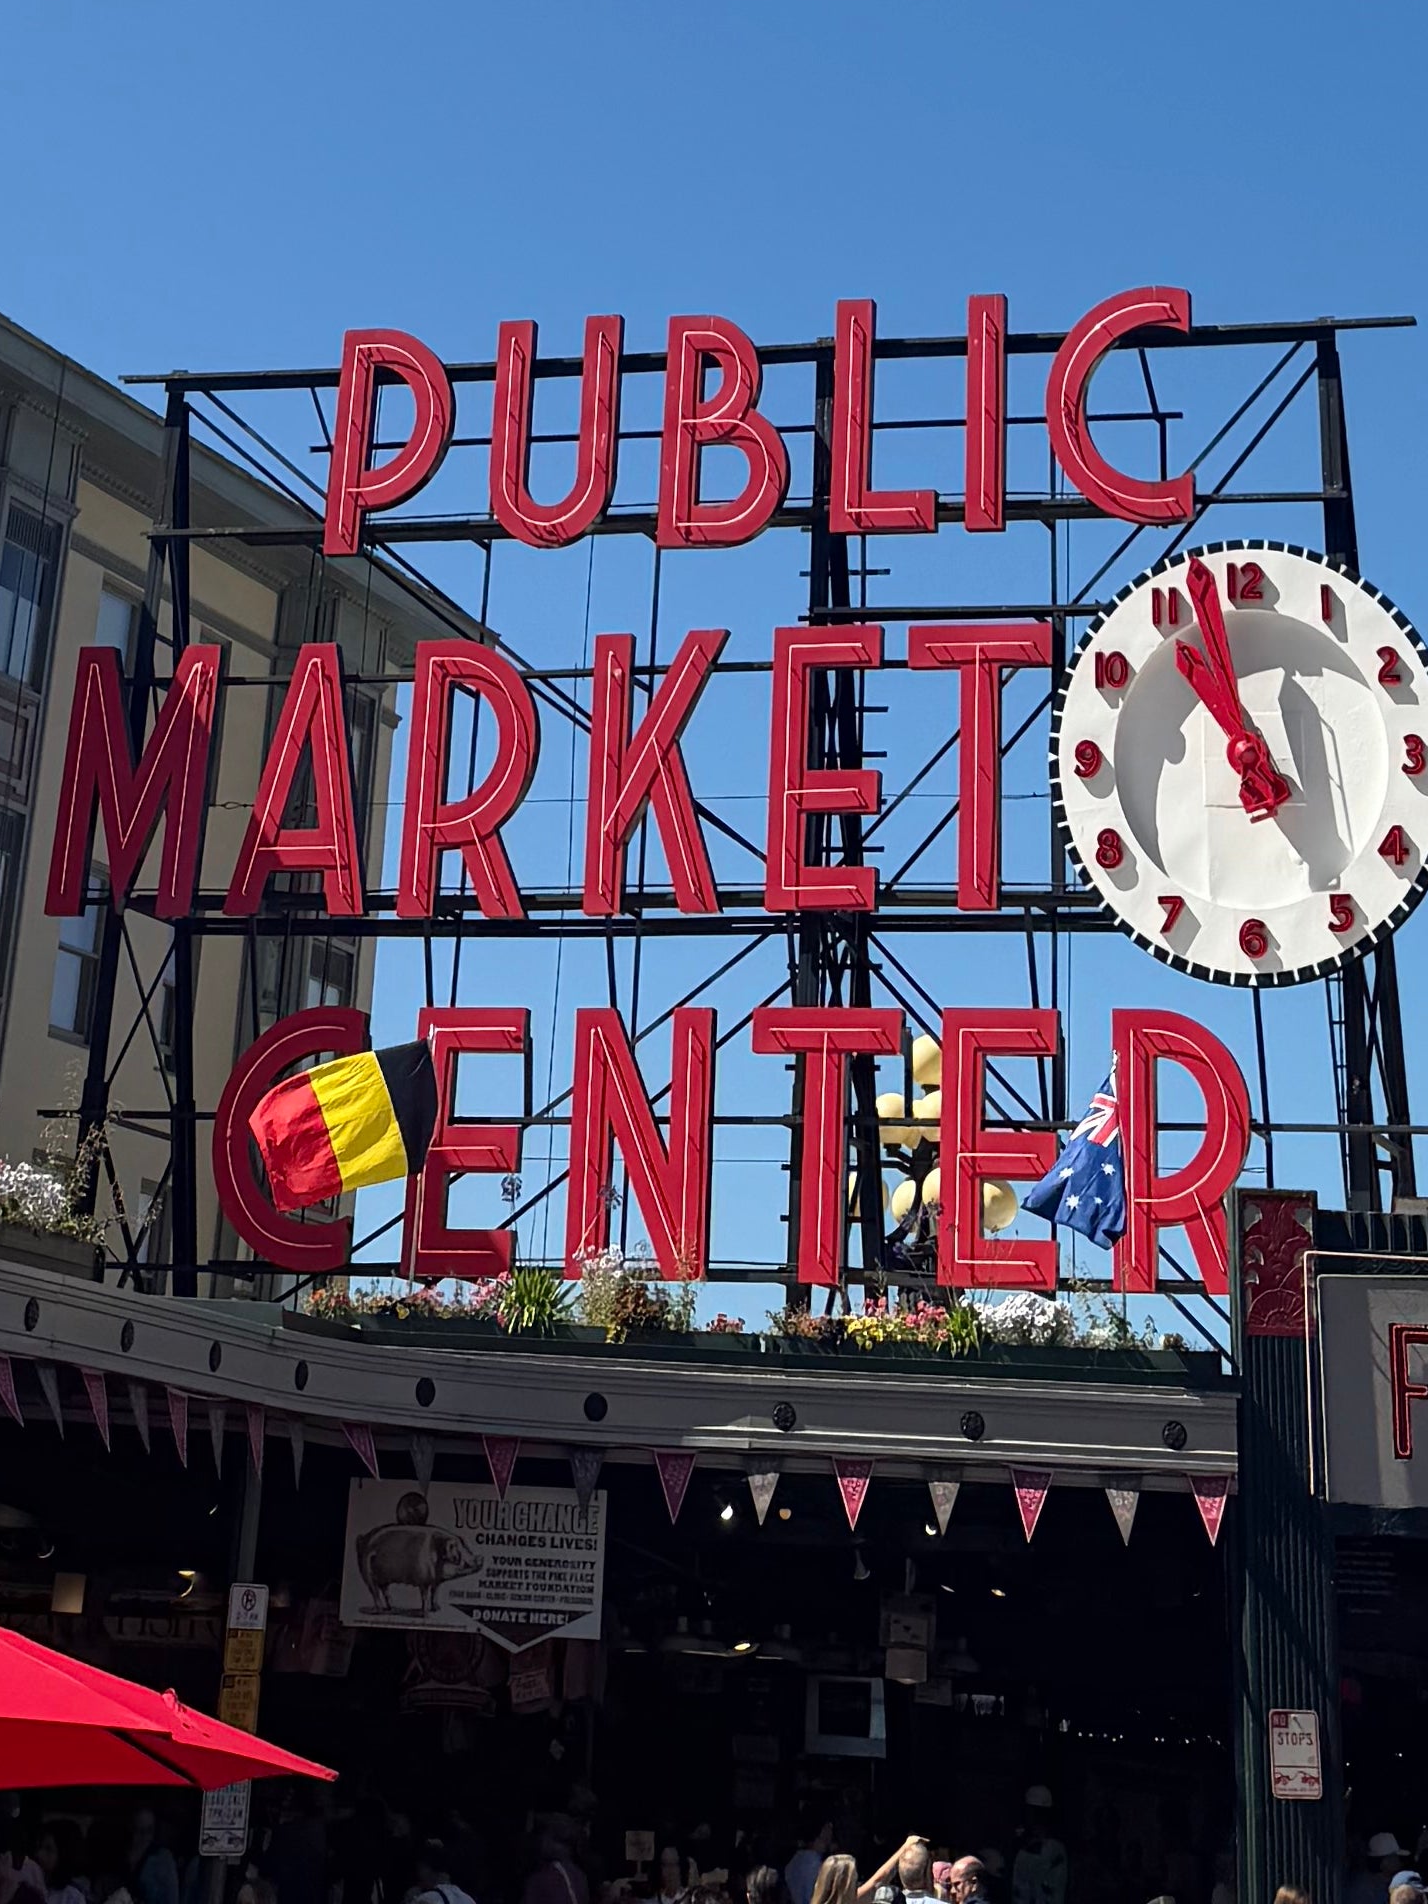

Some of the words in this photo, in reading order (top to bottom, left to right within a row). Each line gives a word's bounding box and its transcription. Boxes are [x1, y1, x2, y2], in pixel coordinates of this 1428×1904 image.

[324, 285, 1198, 557] PUBLIC
[1226, 562, 1263, 600] 12
[1151, 587, 1179, 625] 11
[1321, 584, 1332, 622] 1
[1095, 651, 1129, 689] 10
[1376, 646, 1401, 685] 2
[46, 622, 1055, 920] MARKET
[1074, 740, 1102, 779] 9
[1402, 734, 1426, 775] 3
[1095, 828, 1124, 869] 8
[1378, 825, 1410, 866] 4
[1158, 896, 1184, 934] 7
[1328, 894, 1355, 933] 5
[1239, 919, 1268, 959] 6
[212, 1005, 1252, 1295] CENTER
[513, 1501, 600, 1536] CHANGE
[475, 1533, 546, 1548] CHANGES
[550, 1536, 597, 1551] LIVES!
[492, 1555, 522, 1567] YOUR
[471, 1608, 527, 1623] DONATE
[529, 1611, 569, 1625] HERE!
[1277, 1732, 1314, 1746] STOPS
